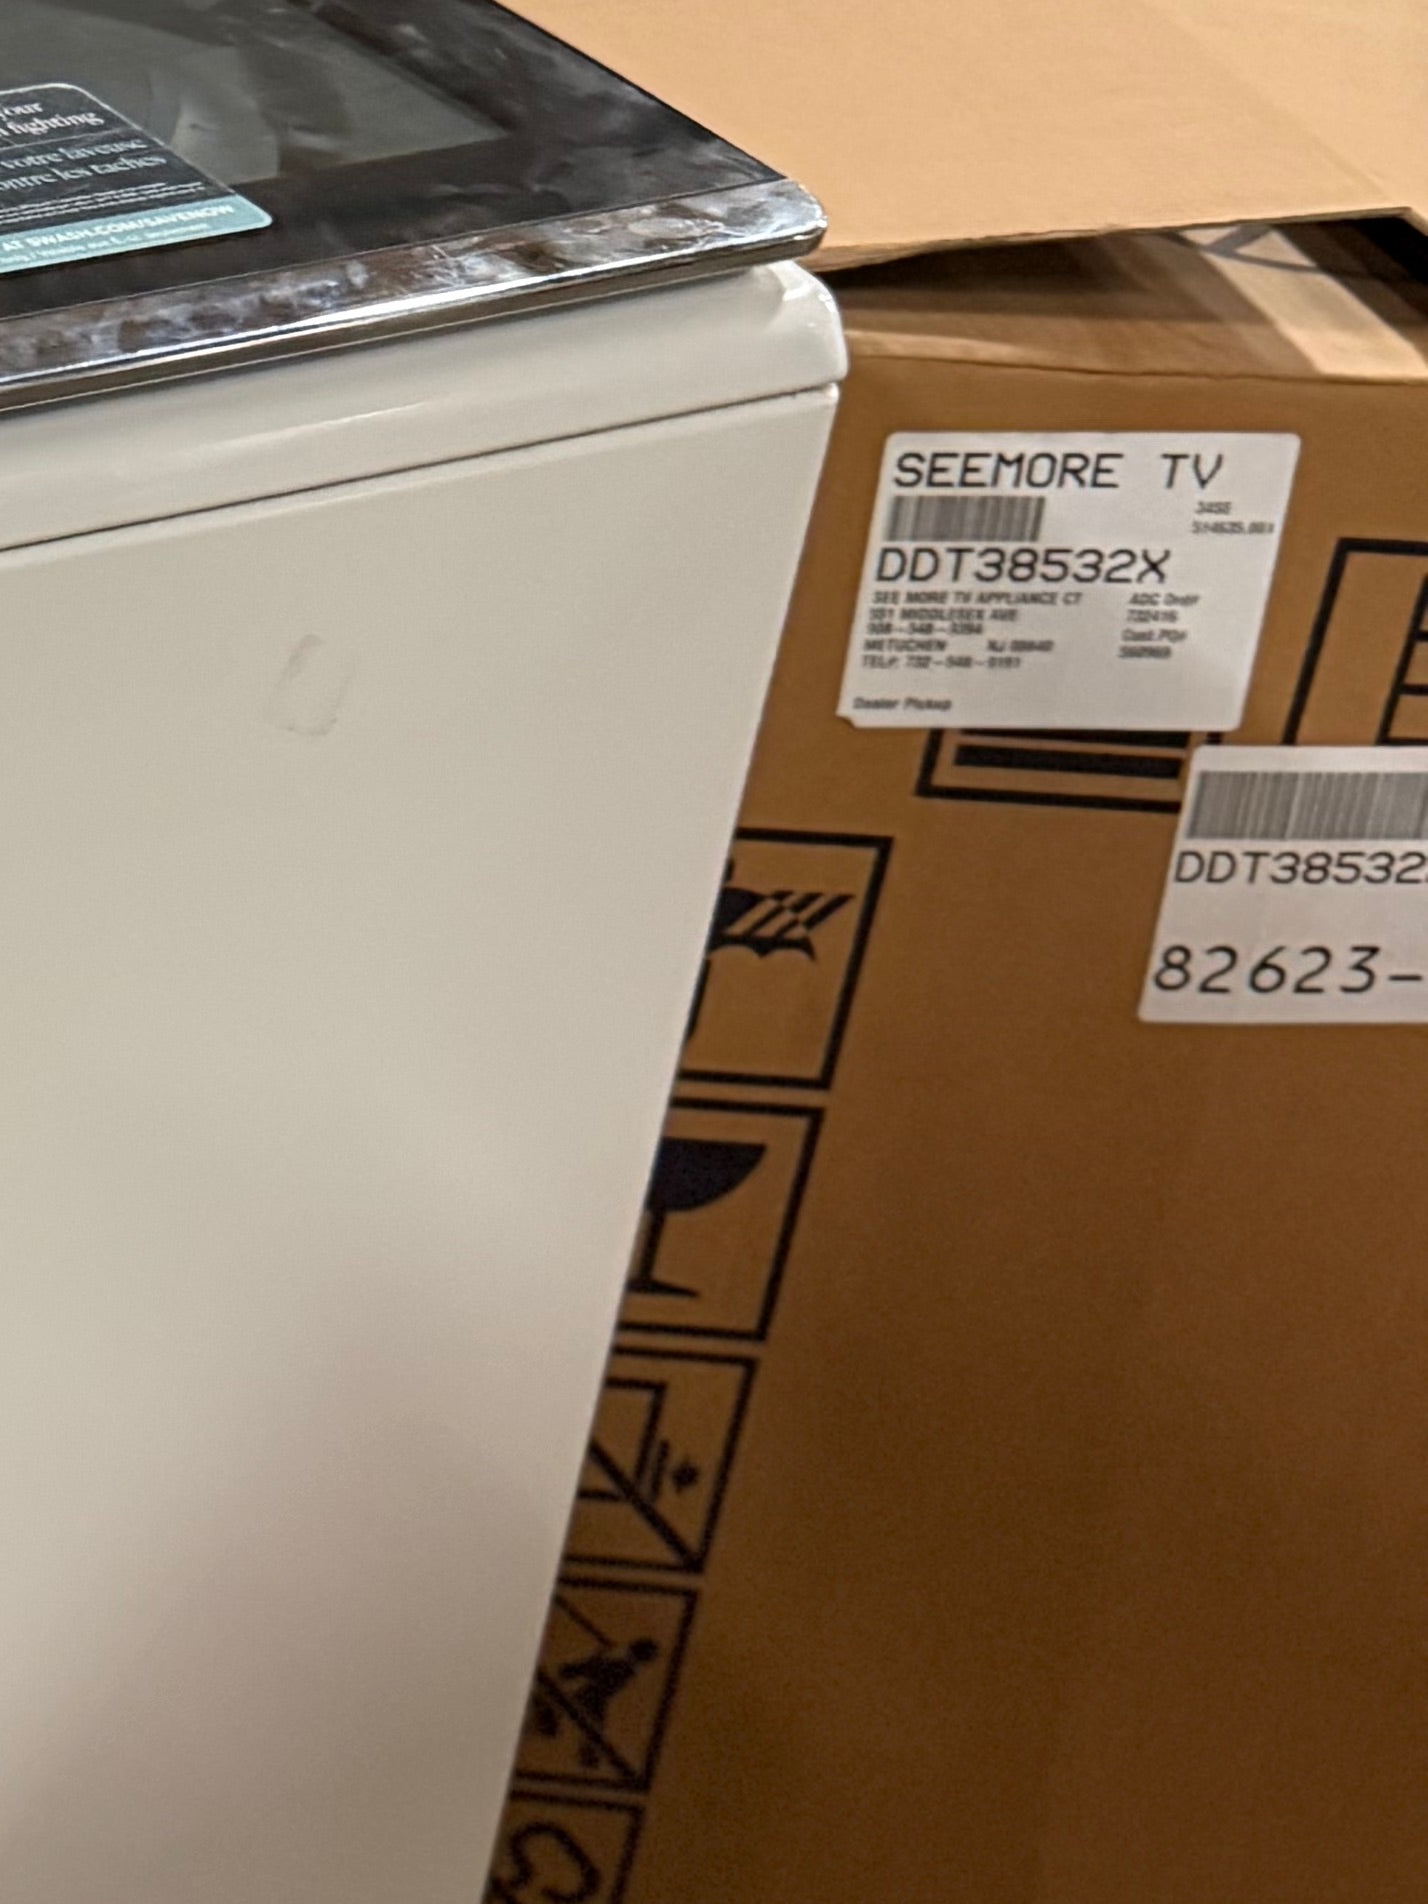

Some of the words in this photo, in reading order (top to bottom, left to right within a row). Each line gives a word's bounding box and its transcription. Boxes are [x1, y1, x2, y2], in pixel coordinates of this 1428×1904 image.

[7, 111, 106, 136] fighting
[0, 152, 63, 171] votre
[58, 138, 148, 161] laveuse
[52, 165, 94, 182] les
[88, 153, 168, 176] taches
[2, 238, 27, 252] AT
[892, 452, 1125, 489] SEEMORE
[1160, 452, 1224, 490] TV
[874, 548, 1172, 585] DDT38532X
[1172, 849, 1428, 886] DDT38532
[1151, 943, 1423, 995] 82623-
